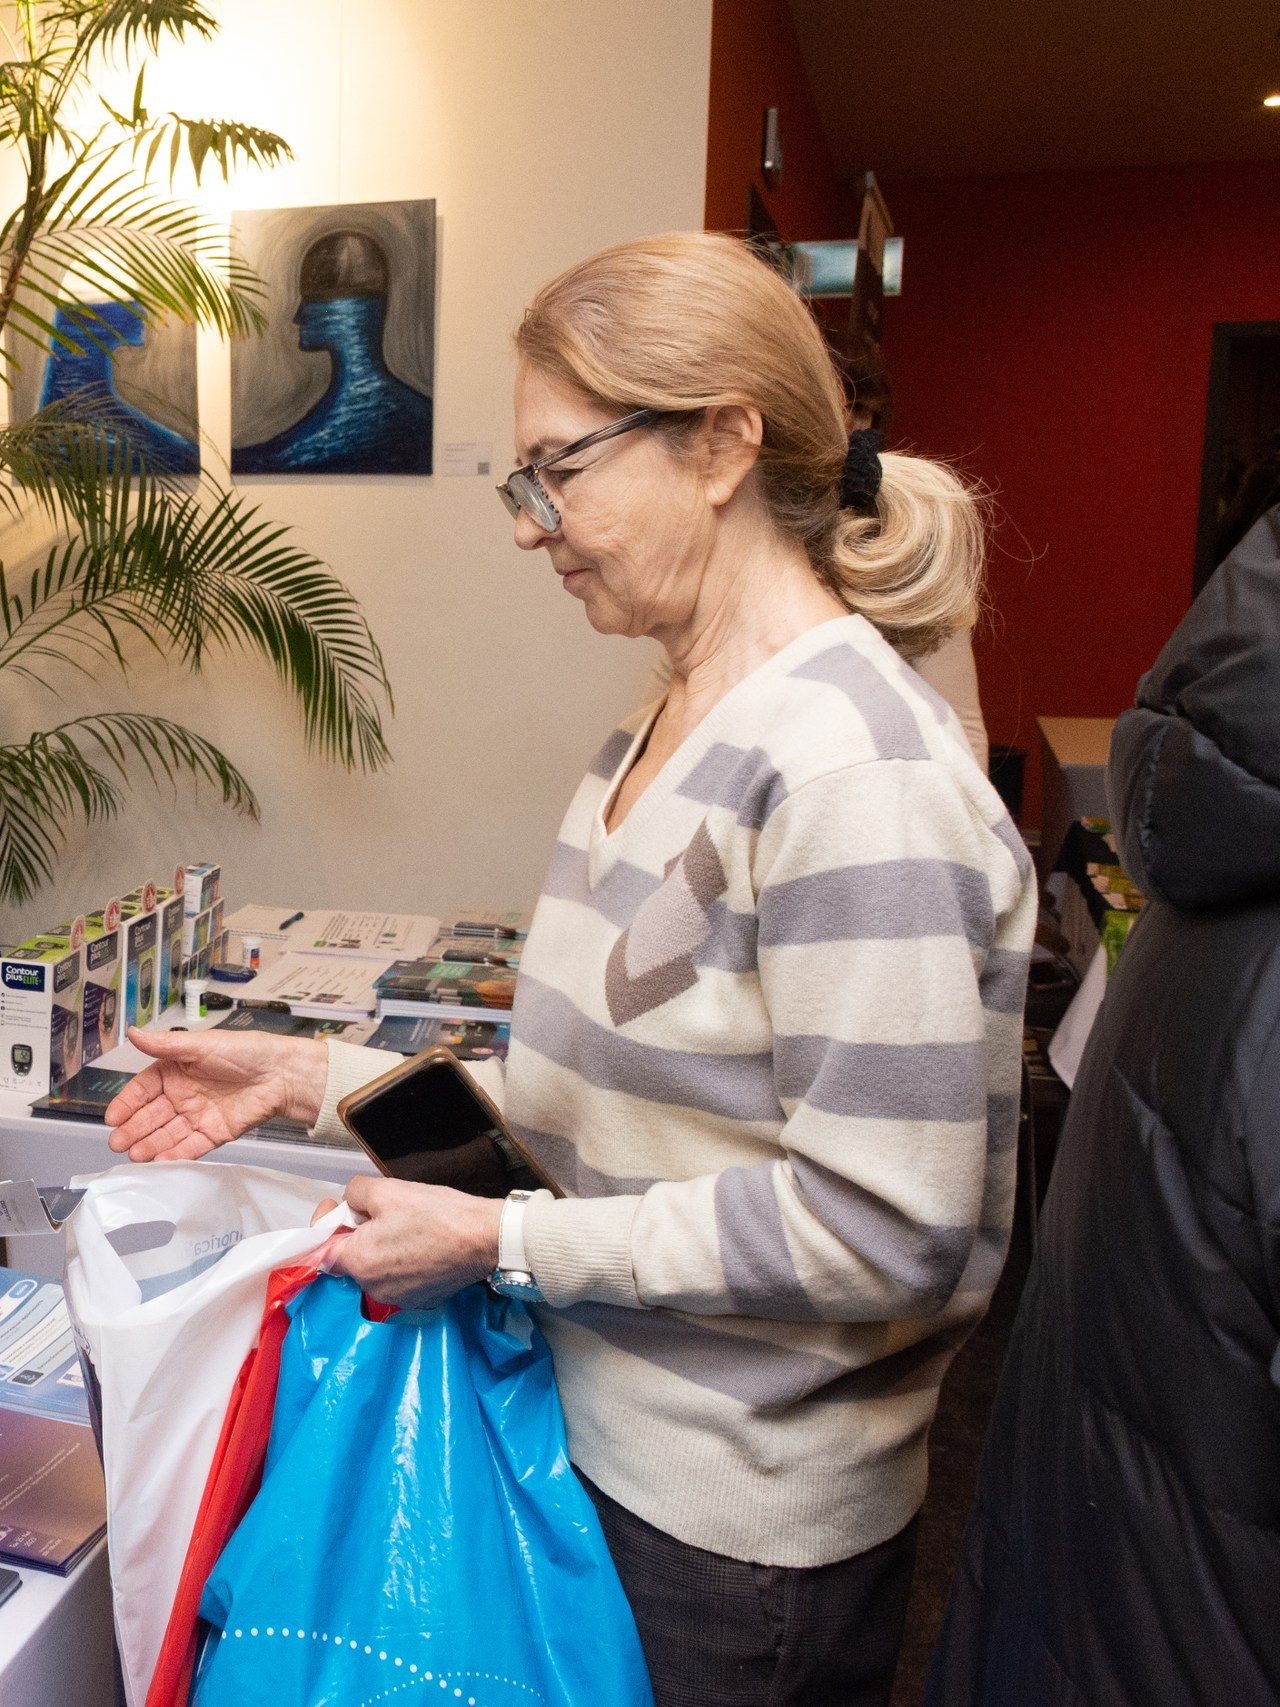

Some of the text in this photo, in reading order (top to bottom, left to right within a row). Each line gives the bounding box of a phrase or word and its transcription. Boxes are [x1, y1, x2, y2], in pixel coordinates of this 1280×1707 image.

[6, 965, 39, 976] Contour
[5, 973, 40, 986] plus ELITE
